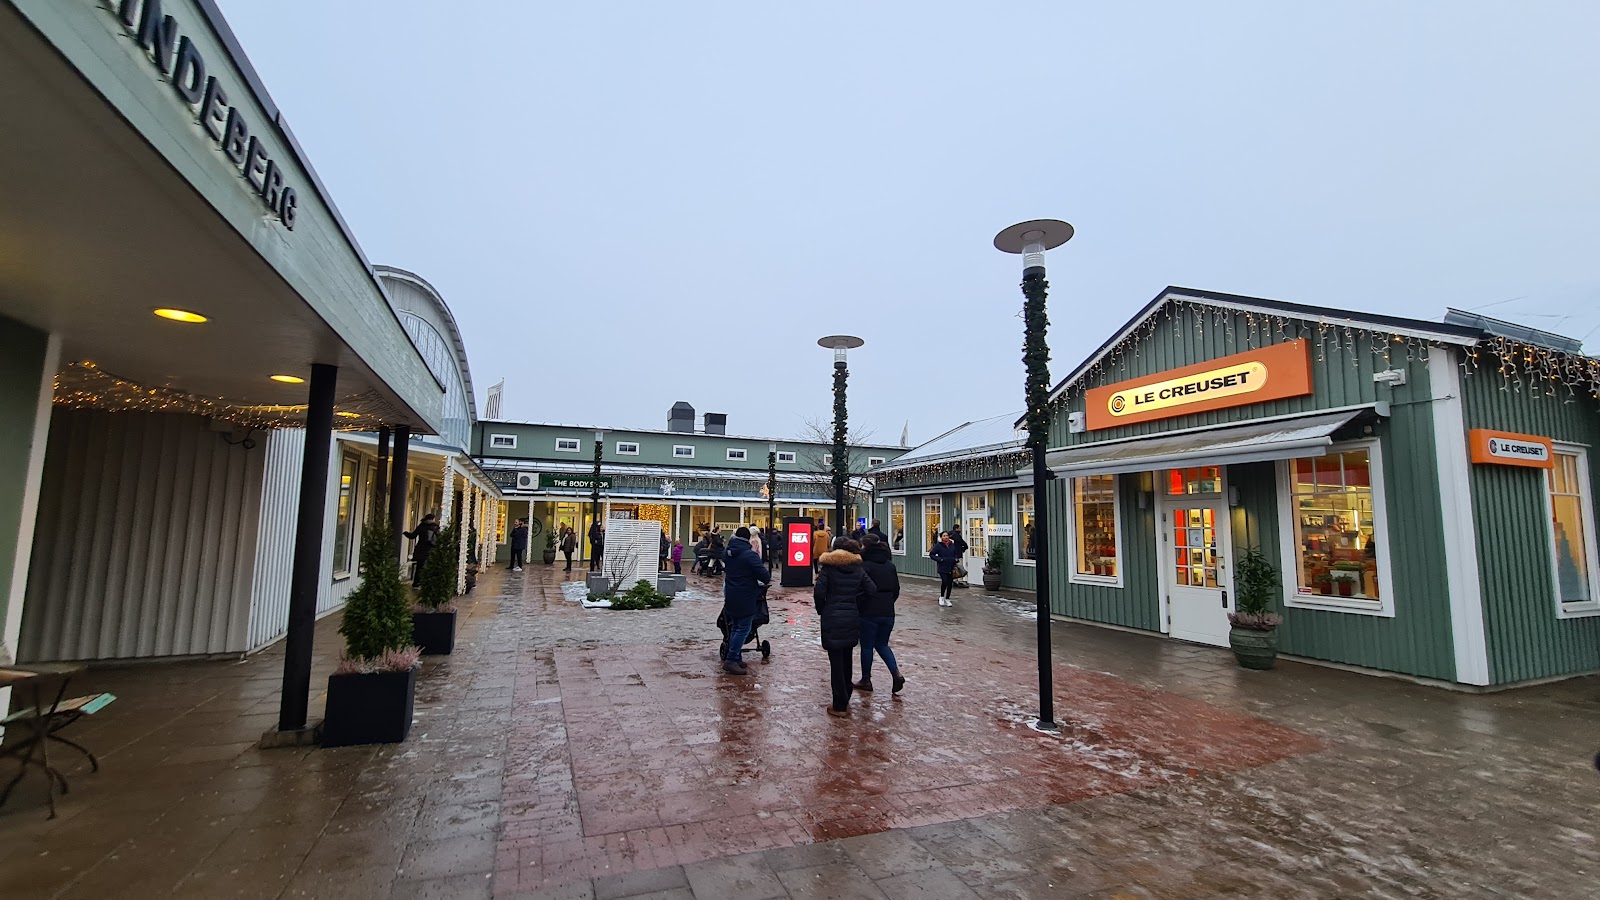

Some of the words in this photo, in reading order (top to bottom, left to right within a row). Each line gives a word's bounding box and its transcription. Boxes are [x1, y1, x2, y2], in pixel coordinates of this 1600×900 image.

[1134, 392, 1155, 405] LE
[1158, 371, 1250, 400] CREUSET
[1501, 443, 1511, 452] LE
[1511, 445, 1543, 456] CREUSET
[791, 535, 808, 543] REA
